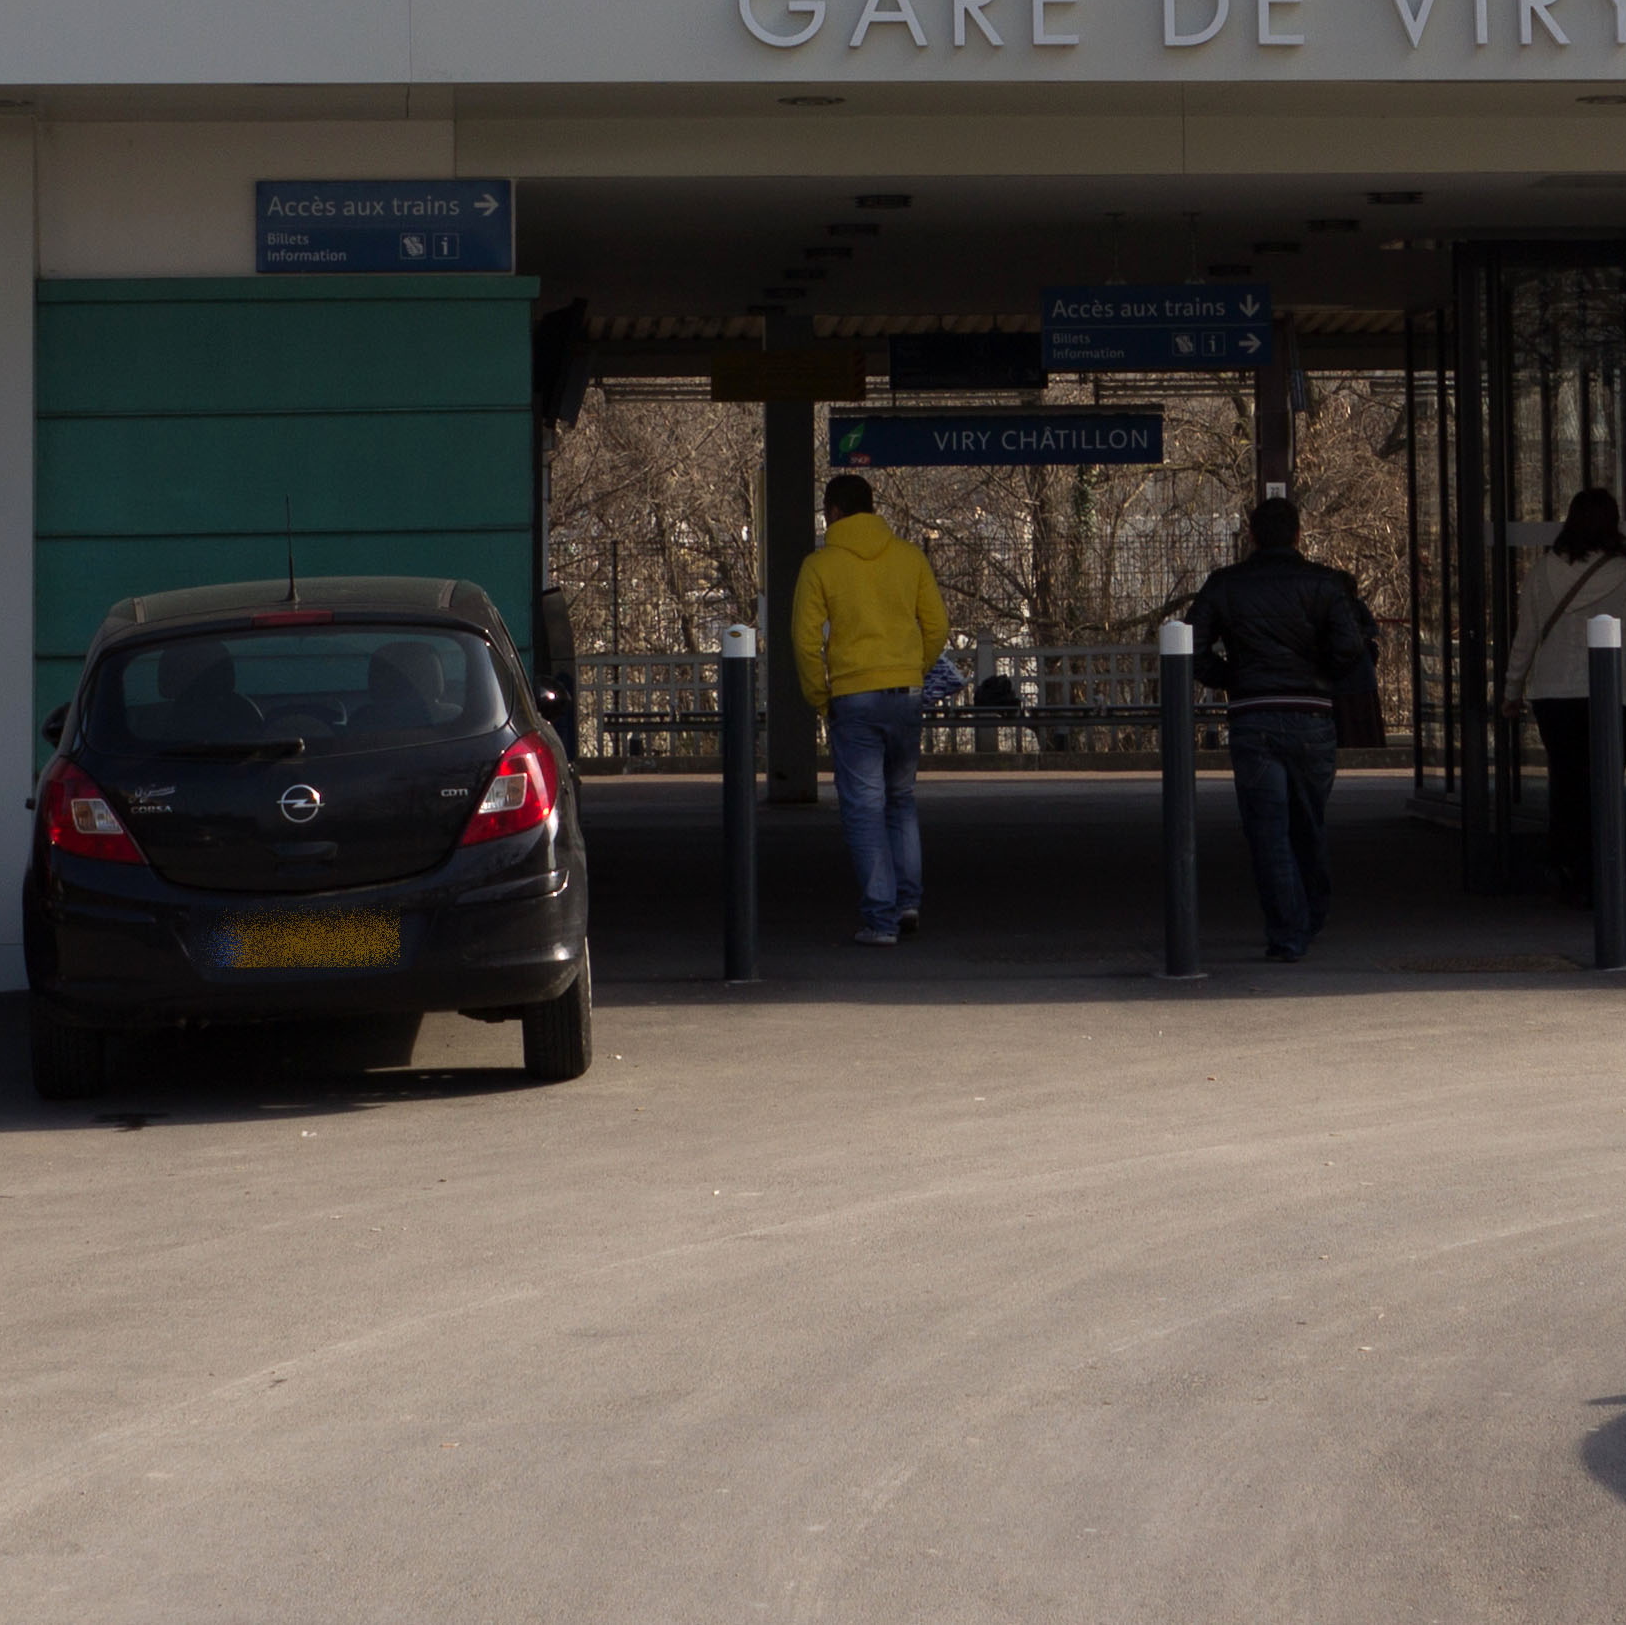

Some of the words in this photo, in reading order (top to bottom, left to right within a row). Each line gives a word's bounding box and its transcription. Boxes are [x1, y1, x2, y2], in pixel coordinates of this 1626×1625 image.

[267, 195, 336, 216] Accès
[342, 201, 384, 217] aux
[393, 196, 460, 216] trains
[267, 233, 309, 246] Billets
[267, 249, 347, 263] Information
[1051, 299, 1114, 319] Accès
[1120, 302, 1158, 318] aux
[1164, 298, 1226, 318] trains
[1052, 333, 1091, 345] Billets
[1052, 348, 1125, 360] Information
[934, 431, 991, 451] VIRY
[1002, 427, 1148, 450] CHÂTILLON
[130, 805, 174, 814] CORSA
